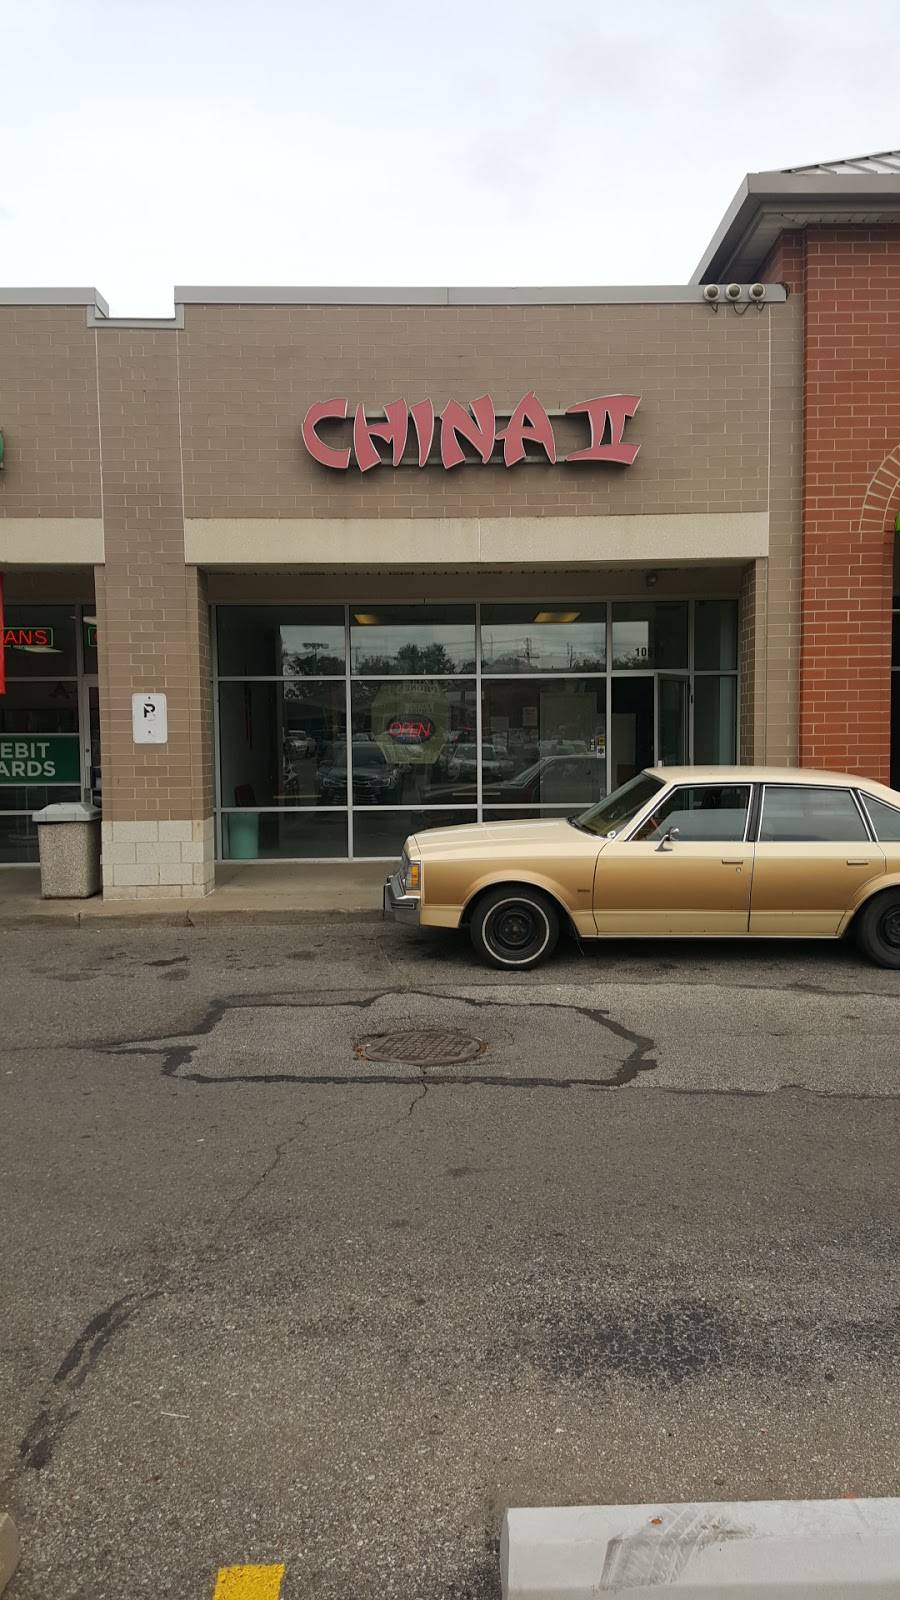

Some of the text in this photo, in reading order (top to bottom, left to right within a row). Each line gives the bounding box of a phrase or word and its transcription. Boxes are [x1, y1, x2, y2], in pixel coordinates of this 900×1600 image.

[302, 391, 642, 472] CHINA II
[0, 742, 50, 758] EBIT
